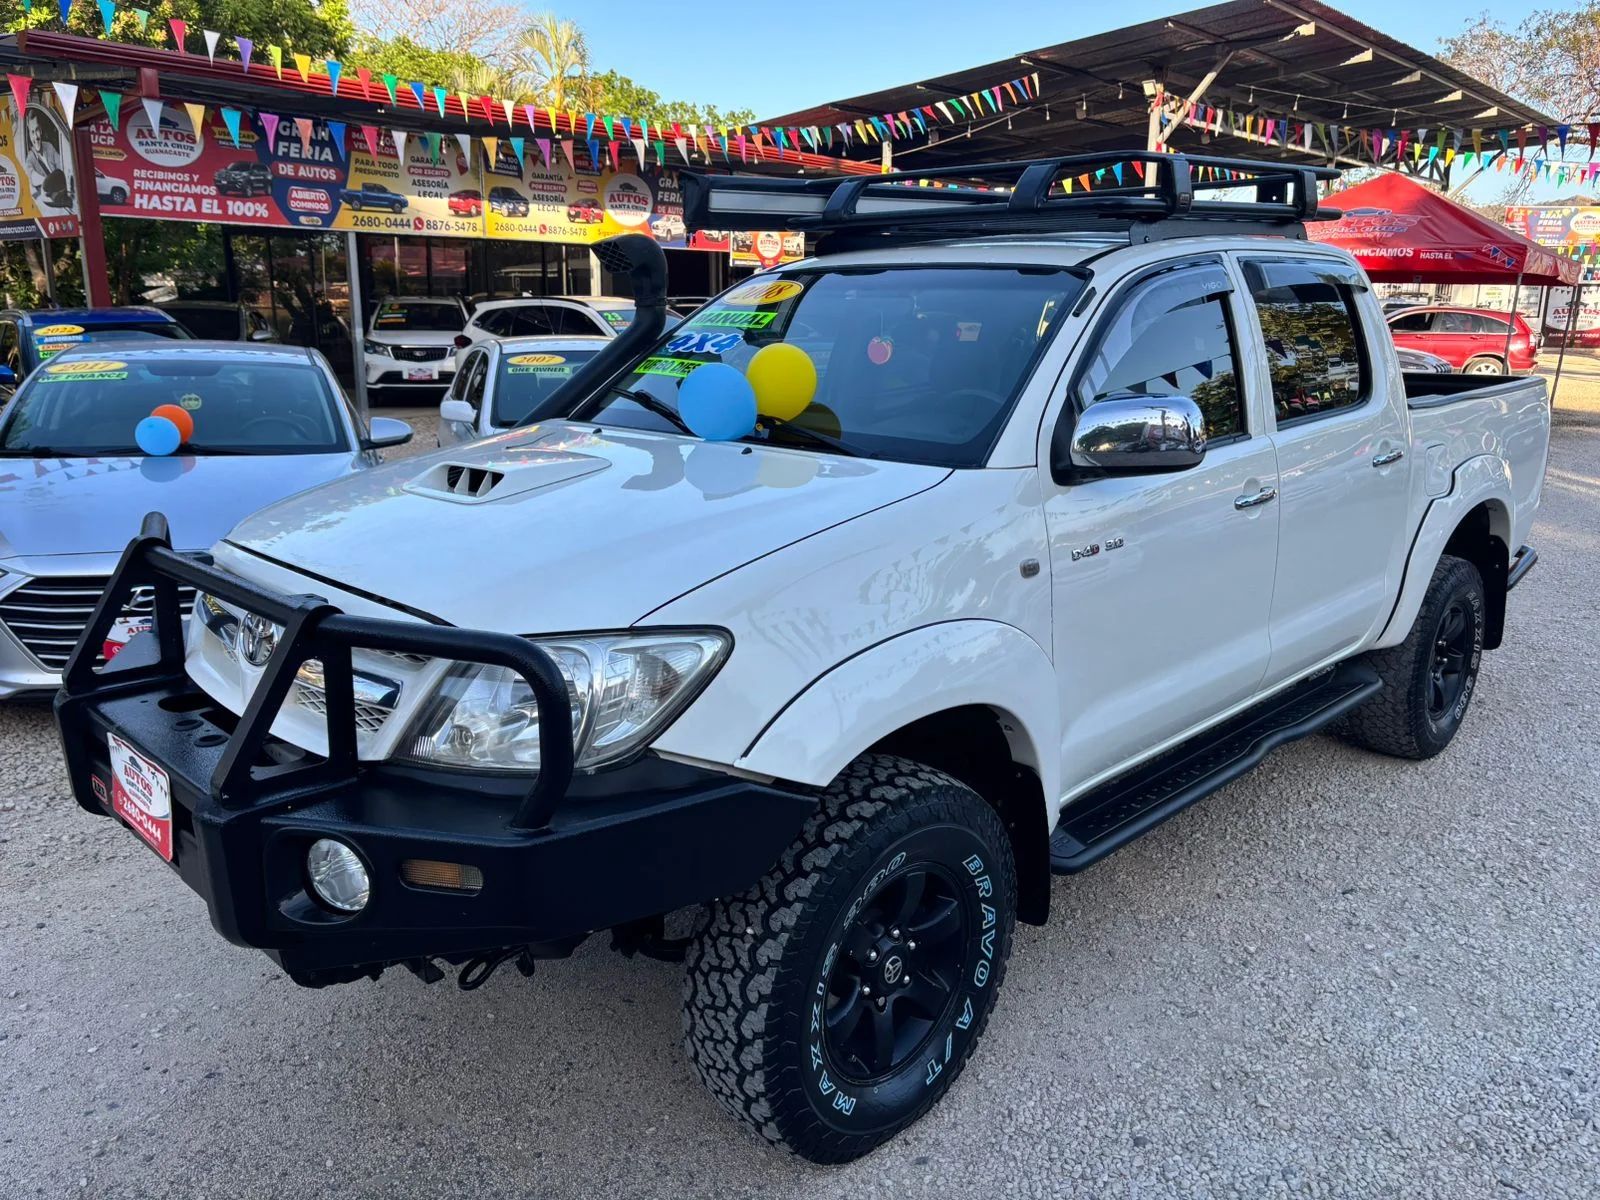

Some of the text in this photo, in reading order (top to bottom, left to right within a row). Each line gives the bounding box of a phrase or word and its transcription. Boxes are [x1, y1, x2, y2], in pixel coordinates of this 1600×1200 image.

[90, 134, 115, 146] UCR
[135, 128, 197, 145] AUTOS
[138, 140, 195, 152] SANTA CRUZ
[277, 141, 334, 163] FERIA
[354, 158, 399, 171] PARA TODO
[133, 169, 200, 181] RECIBIMOS Y
[278, 163, 337, 181] DE AUTOS
[354, 167, 399, 178] PRESUPUESTO
[423, 168, 449, 178] ESCRITO
[531, 171, 564, 182] GARANTÍA
[133, 179, 217, 196] FINANCIAMOS
[411, 178, 449, 189] ASESORÍA
[658, 177, 679, 188] GRA
[417, 190, 443, 199] LEGAL
[532, 193, 566, 203] ASESORÍA
[608, 193, 649, 206] AUTOS
[657, 191, 684, 203] FERI
[134, 194, 269, 218] HASTA EL 100%
[537, 204, 560, 213] LEGAL
[667, 207, 684, 215] AUTO
[352, 215, 478, 232] 2680-0444 8876-5478
[494, 222, 537, 233] 2680-0444
[548, 226, 588, 237] 8876-5478
[1201, 281, 1222, 289] VIGO
[700, 312, 768, 325] MANUAL
[518, 355, 556, 364] 2007
[57, 361, 114, 372] 2017
[639, 358, 672, 374] TURBO
[64, 372, 126, 380] FINANCE
[123, 764, 153, 798] AUTOS
[122, 797, 162, 843] 2680-0444
[962, 854, 997, 988] BRAVO
